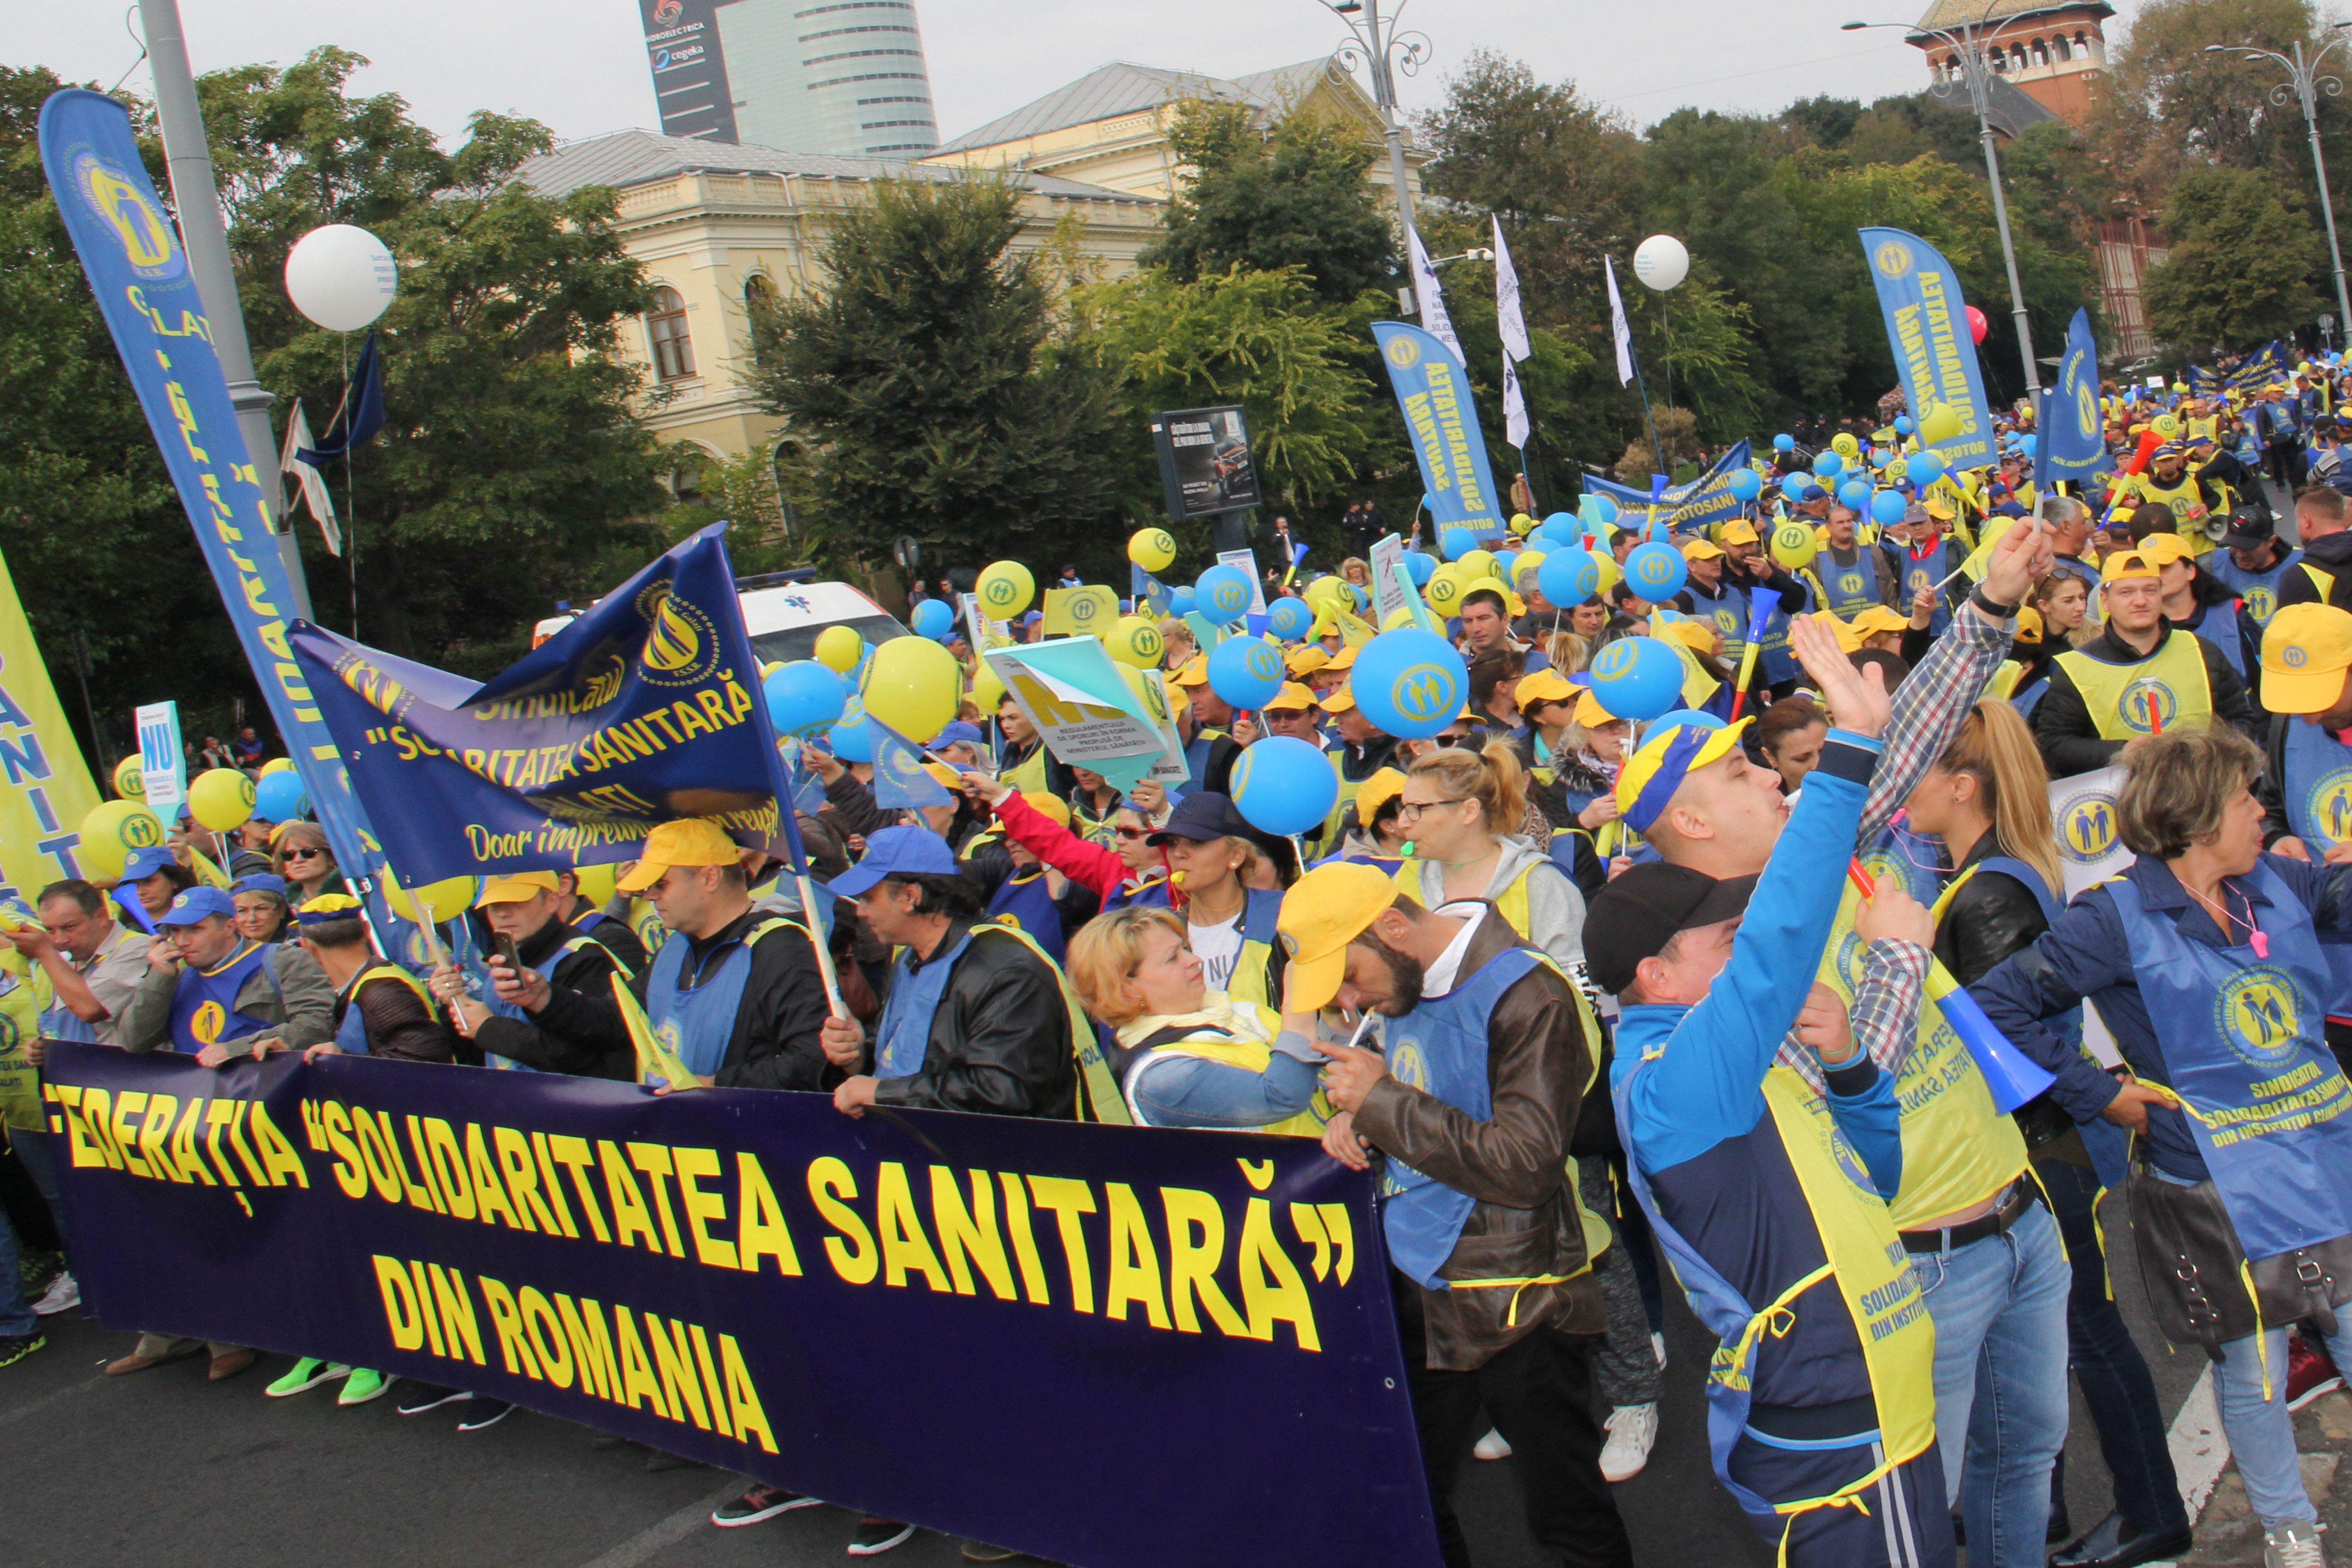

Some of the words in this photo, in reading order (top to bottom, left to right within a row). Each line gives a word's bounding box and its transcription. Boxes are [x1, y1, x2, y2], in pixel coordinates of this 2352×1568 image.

[671, 45, 704, 60] cegeka
[578, 668, 753, 772] SANITARĂ
[1068, 731, 1099, 740] SPORURI
[140, 722, 175, 773] NU
[1066, 745, 1110, 754] MINISTERUL
[465, 823, 532, 863] Doar
[2249, 1060, 2323, 1098] SINDICATUL
[2204, 1088, 2323, 1130] SOLIDARITATEA
[2211, 1128, 2239, 1148] DIN
[301, 1098, 804, 1277] “SOLIDARITATEA
[807, 1156, 1354, 1352] SANITARĂ”
[1869, 1315, 1894, 1341] DIN
[372, 1254, 487, 1366] DIN
[478, 1274, 780, 1455] ROMANIA
